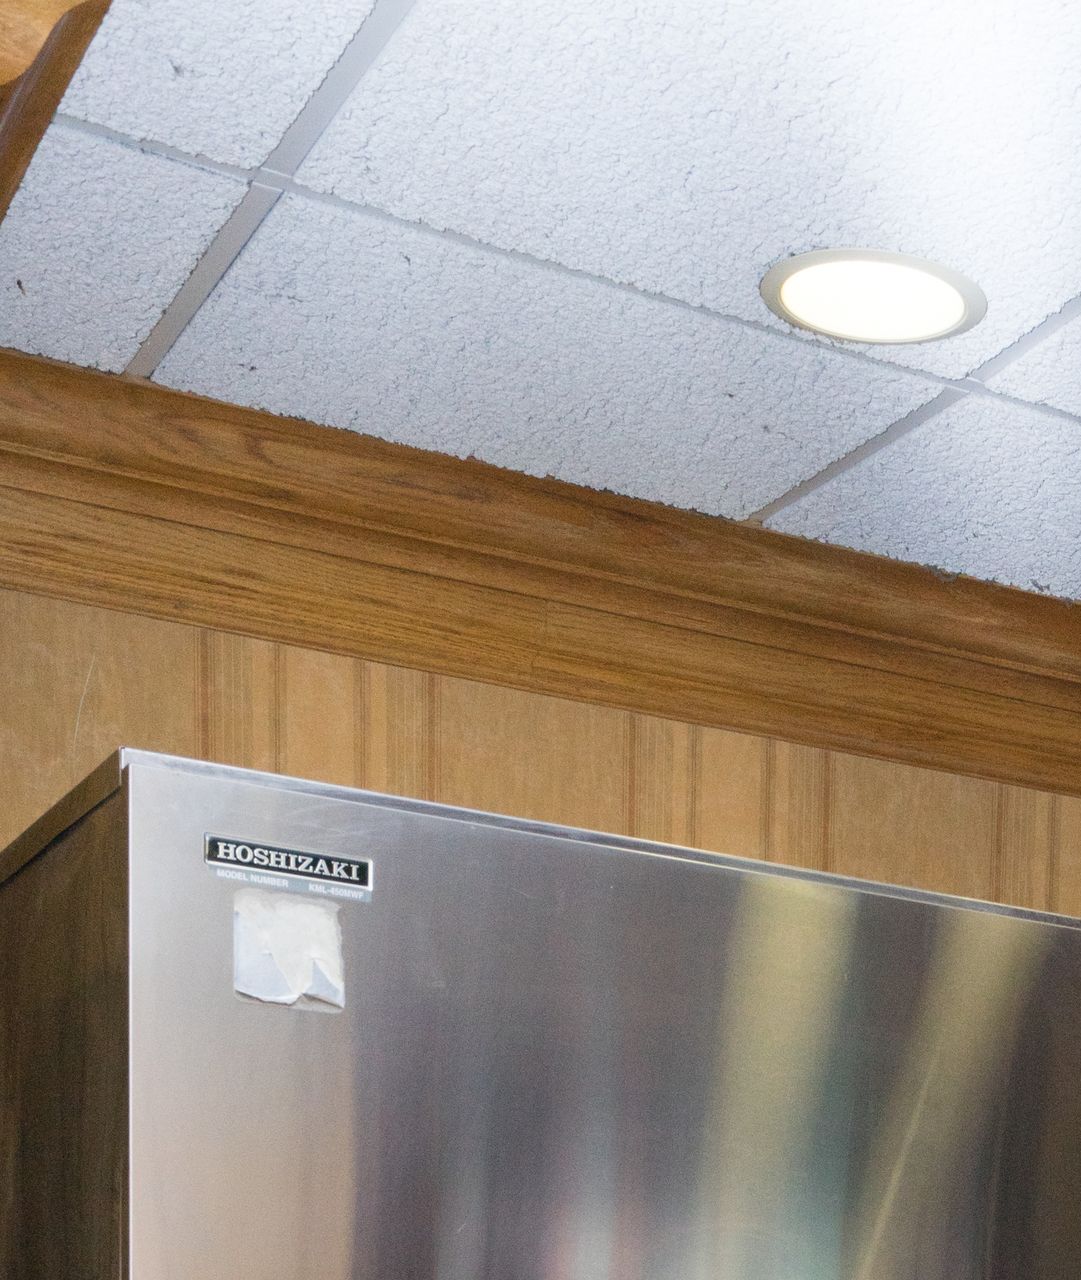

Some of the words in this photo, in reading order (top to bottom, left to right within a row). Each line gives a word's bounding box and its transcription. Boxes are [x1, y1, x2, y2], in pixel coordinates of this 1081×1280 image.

[217, 841, 360, 881] HOSHIZAKI
[217, 869, 248, 881] MODEL
[251, 875, 289, 888] NUMBER
